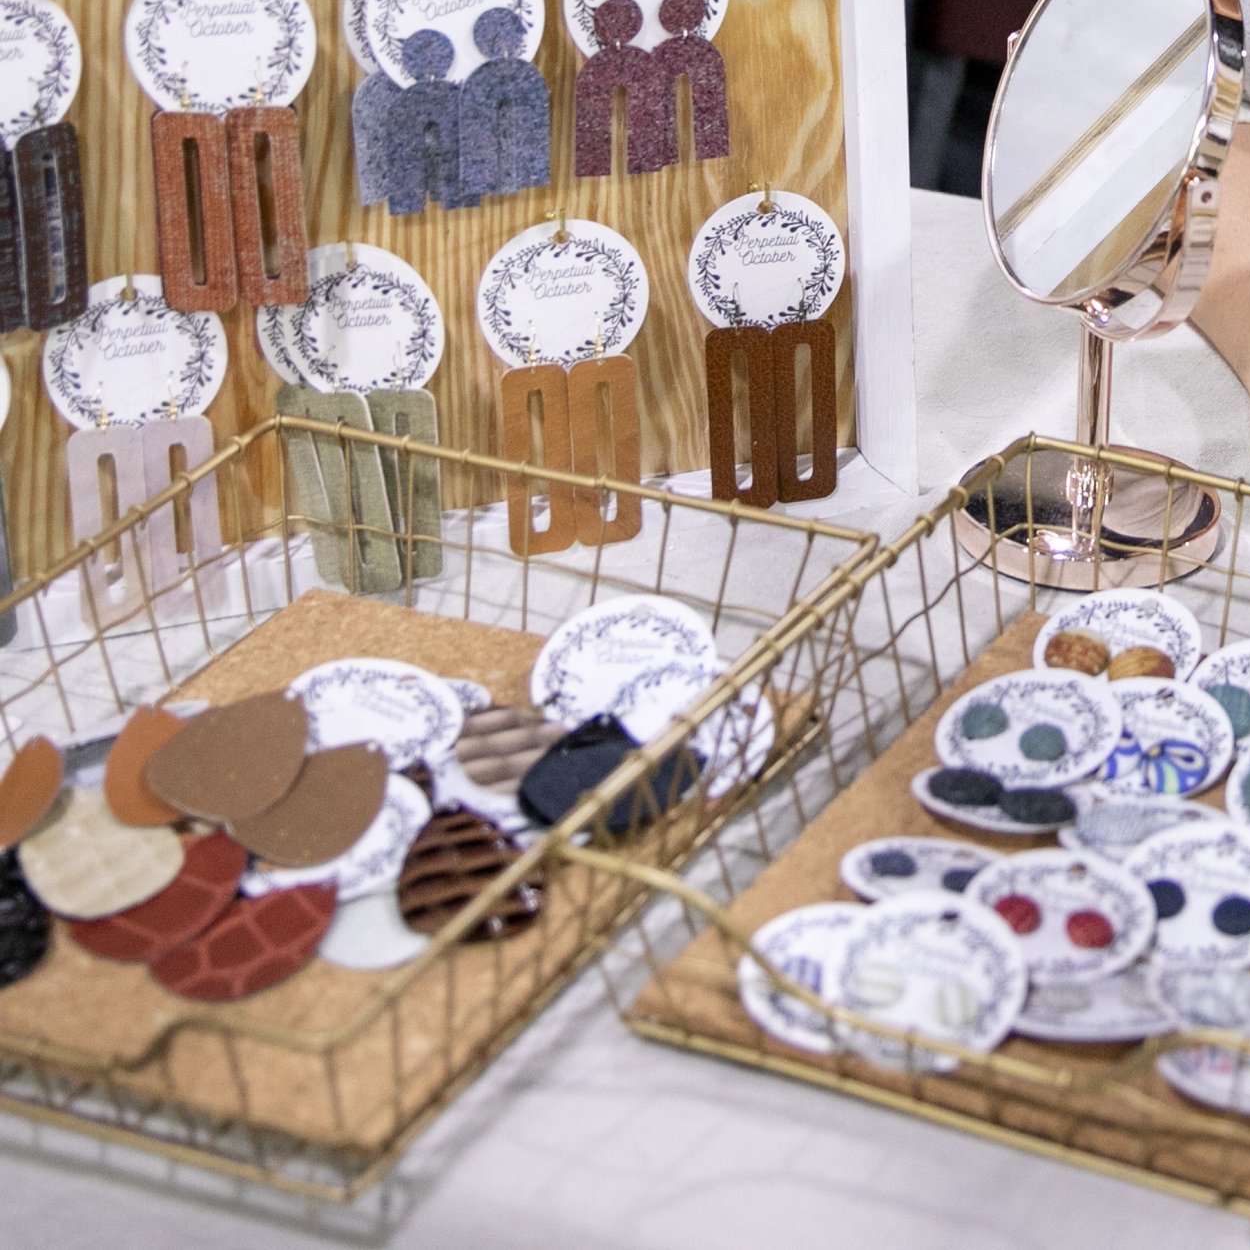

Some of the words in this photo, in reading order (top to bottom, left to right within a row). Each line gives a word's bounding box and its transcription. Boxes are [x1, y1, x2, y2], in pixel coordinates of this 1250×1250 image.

[734, 232, 801, 250] Perpetual
[739, 249, 797, 267] October
[525, 261, 596, 284] Perpetual
[530, 282, 592, 300] October
[326, 294, 393, 314] Perpetual
[333, 312, 392, 330] October
[93, 320, 170, 342] Perpetual
[98, 340, 166, 361] October
